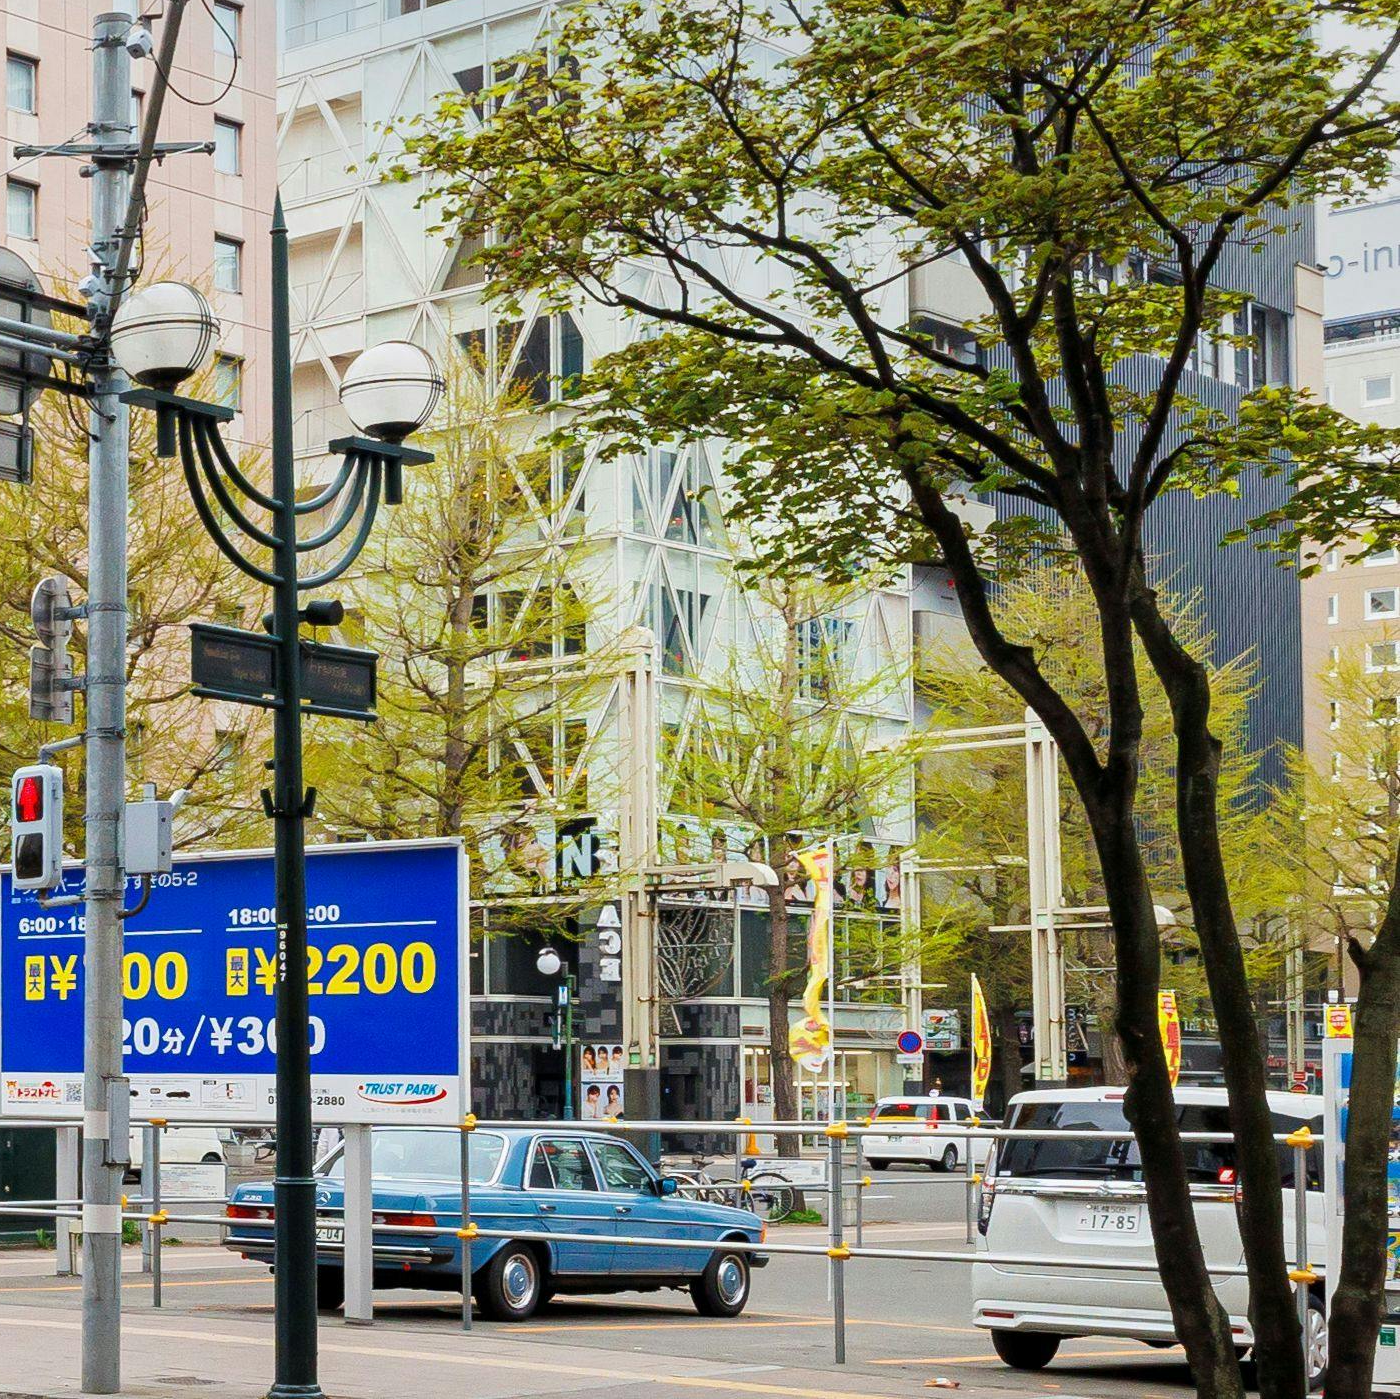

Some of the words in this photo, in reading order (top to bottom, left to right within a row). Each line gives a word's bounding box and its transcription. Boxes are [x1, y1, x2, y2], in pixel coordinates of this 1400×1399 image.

[19, 917, 57, 934] 6:00
[279, 930, 287, 982] 96047
[28, 964, 42, 992] 最大
[50, 951, 189, 1001] ¥00
[230, 955, 245, 988] 最大
[17, 1088, 62, 1099] トラストナビ
[364, 1083, 403, 1096] TRUST
[404, 1084, 438, 1096] PARK
[1091, 1214, 1136, 1231] 17-85
